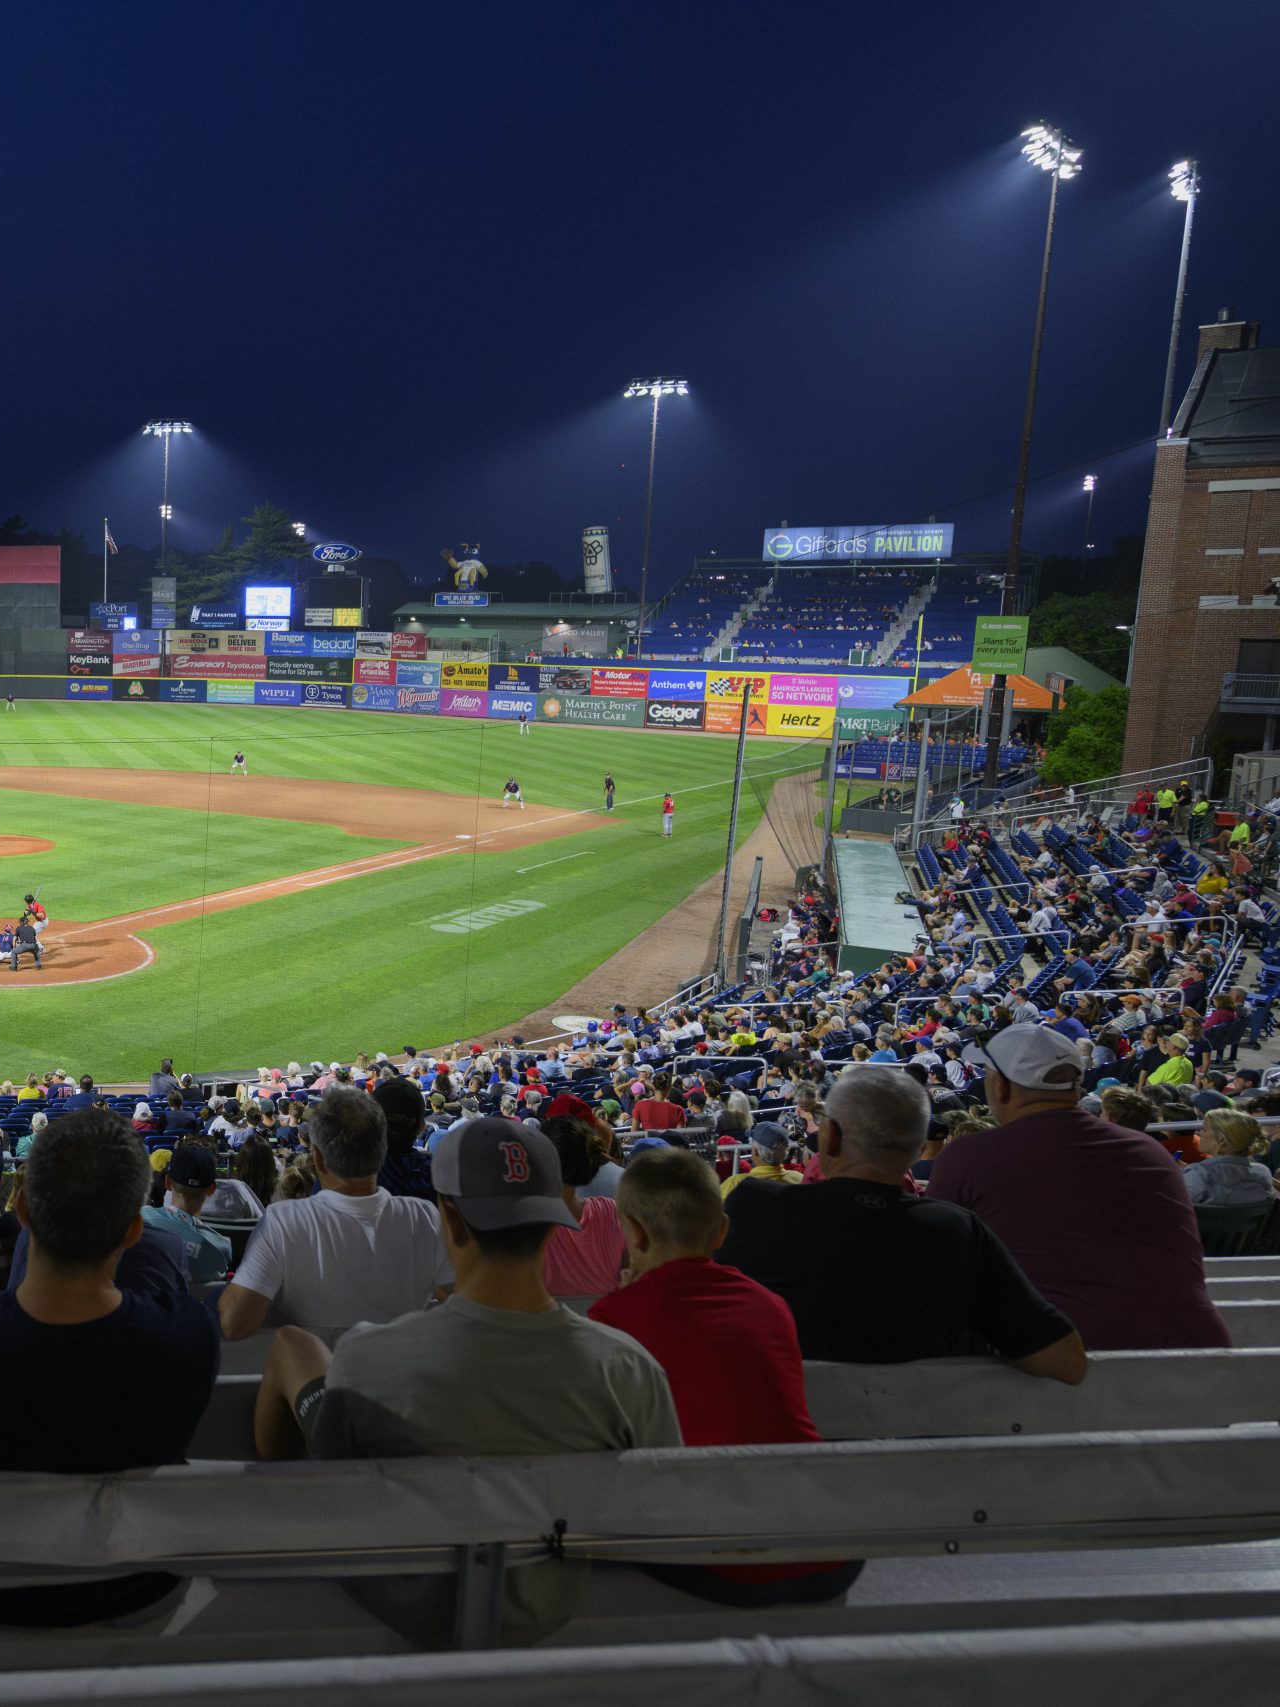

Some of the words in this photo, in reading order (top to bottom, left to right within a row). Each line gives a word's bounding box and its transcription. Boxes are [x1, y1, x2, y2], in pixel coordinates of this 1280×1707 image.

[796, 534, 868, 555] Gifford's
[874, 535, 943, 553] PAVILION
[320, 547, 348, 560] Ford
[106, 604, 127, 612] cPort
[257, 619, 283, 628] Norway
[337, 615, 358, 626] JOE
[70, 637, 109, 645] FARMINGTON
[272, 632, 305, 643] Bangor
[313, 636, 355, 650] bedard
[983, 637, 1004, 646] Plans
[1006, 637, 1018, 646] for
[976, 648, 998, 656] every
[999, 647, 1023, 655] smile!
[69, 655, 110, 665] KeyBank
[174, 656, 225, 670] Emerson
[226, 663, 266, 671] Toyota.com
[269, 661, 292, 669] Proudly
[292, 662, 315, 670] serving
[457, 666, 488, 676] Amato's
[369, 685, 395, 696] MANN
[651, 680, 686, 690] Anthem
[728, 676, 765, 693] VIP
[261, 688, 295, 698] WIPFLI
[322, 691, 342, 700] Tyson
[397, 687, 439, 708] Wyman's
[771, 691, 784, 700] 5G
[785, 692, 833, 703] NETWORK
[372, 697, 390, 706] LAW
[450, 695, 482, 711] Jordan's
[491, 700, 533, 712] MEMIC
[565, 699, 607, 710] MARTIN'S
[609, 701, 637, 712] POINT
[565, 709, 601, 720] HEALTH
[603, 711, 627, 722] CARE
[648, 703, 700, 721] Geiger
[780, 713, 822, 727] Hertz
[840, 717, 871, 731] M&T
[871, 718, 900, 733] Bank
[499, 1141, 530, 1183] B
